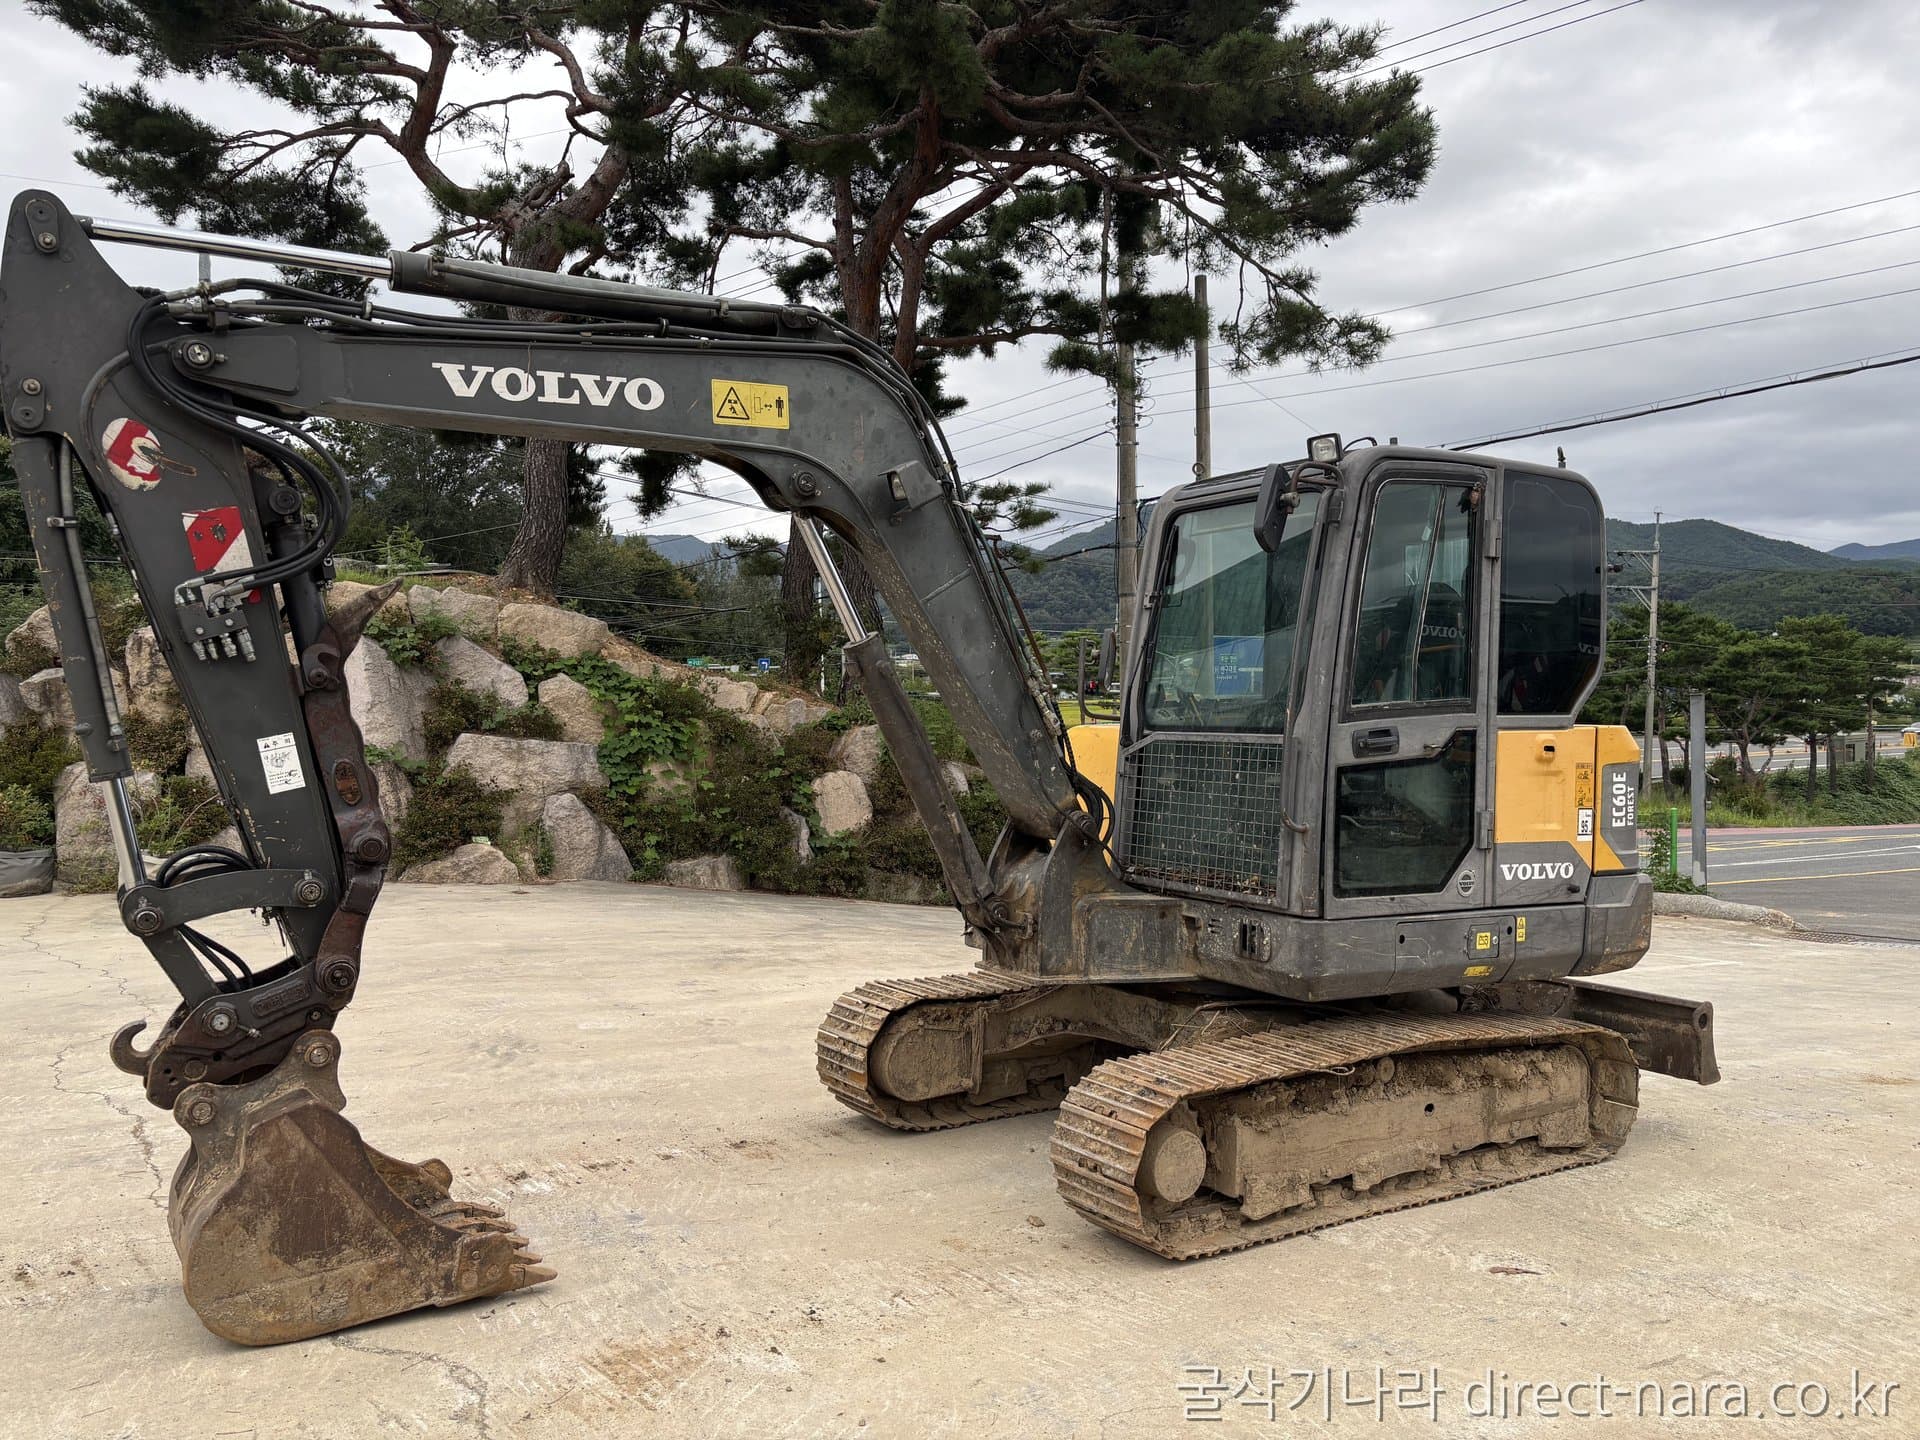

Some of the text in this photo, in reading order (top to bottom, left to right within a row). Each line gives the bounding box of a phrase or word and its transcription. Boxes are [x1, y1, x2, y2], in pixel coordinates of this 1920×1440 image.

[431, 362, 665, 411] VOLVO
[1612, 772, 1626, 827] EC60E
[1627, 786, 1635, 826] FOREST
[1501, 862, 1574, 881] VOLVO
